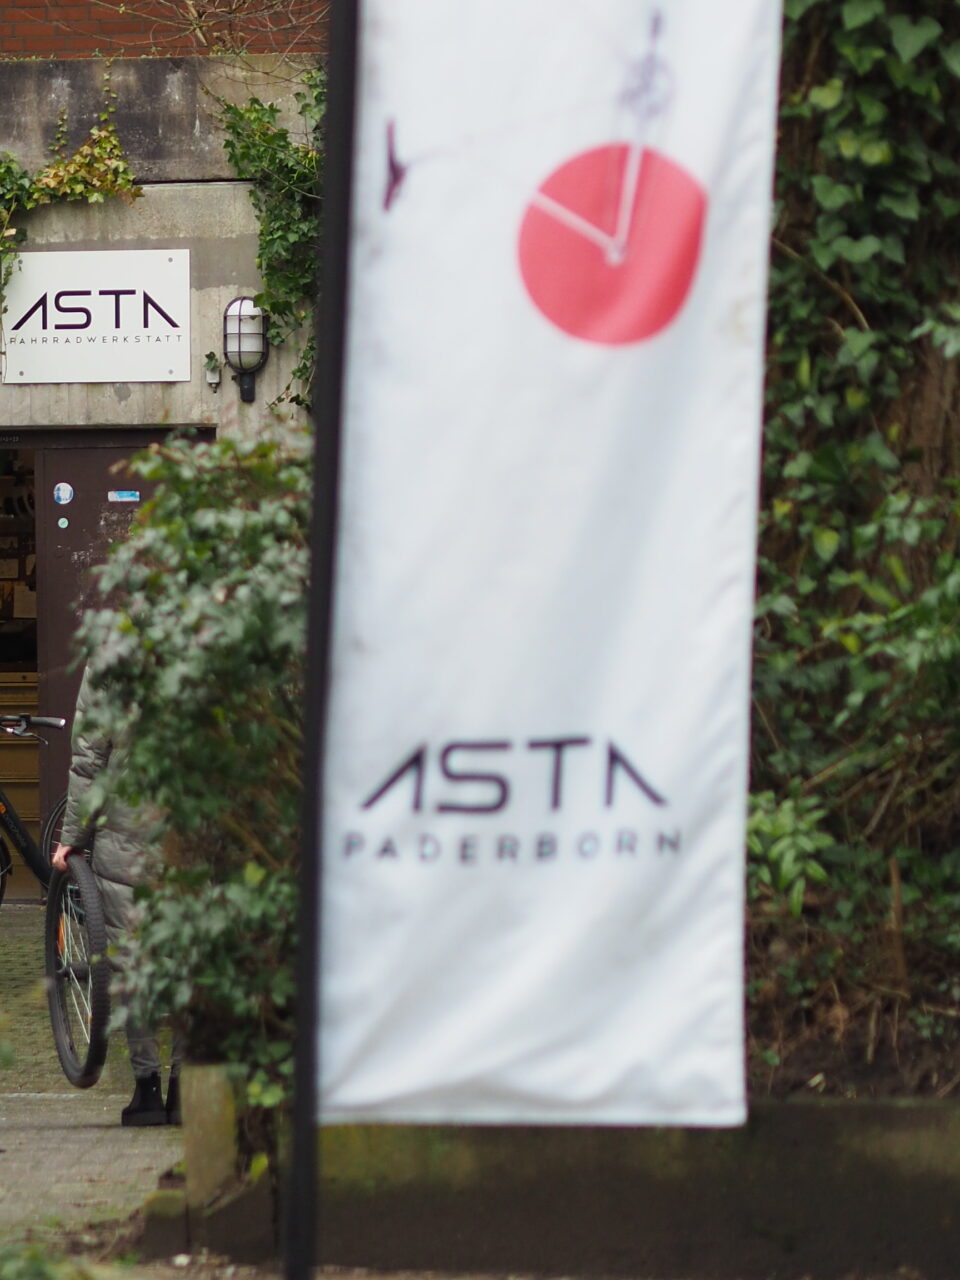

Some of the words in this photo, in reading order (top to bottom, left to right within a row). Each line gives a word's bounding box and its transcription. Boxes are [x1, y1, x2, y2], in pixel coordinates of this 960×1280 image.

[11, 289, 180, 330] ASTA
[10, 335, 182, 344] FAHRRADWERKSTATT
[361, 736, 667, 813] ASTA
[343, 829, 682, 864] PADERBORN
